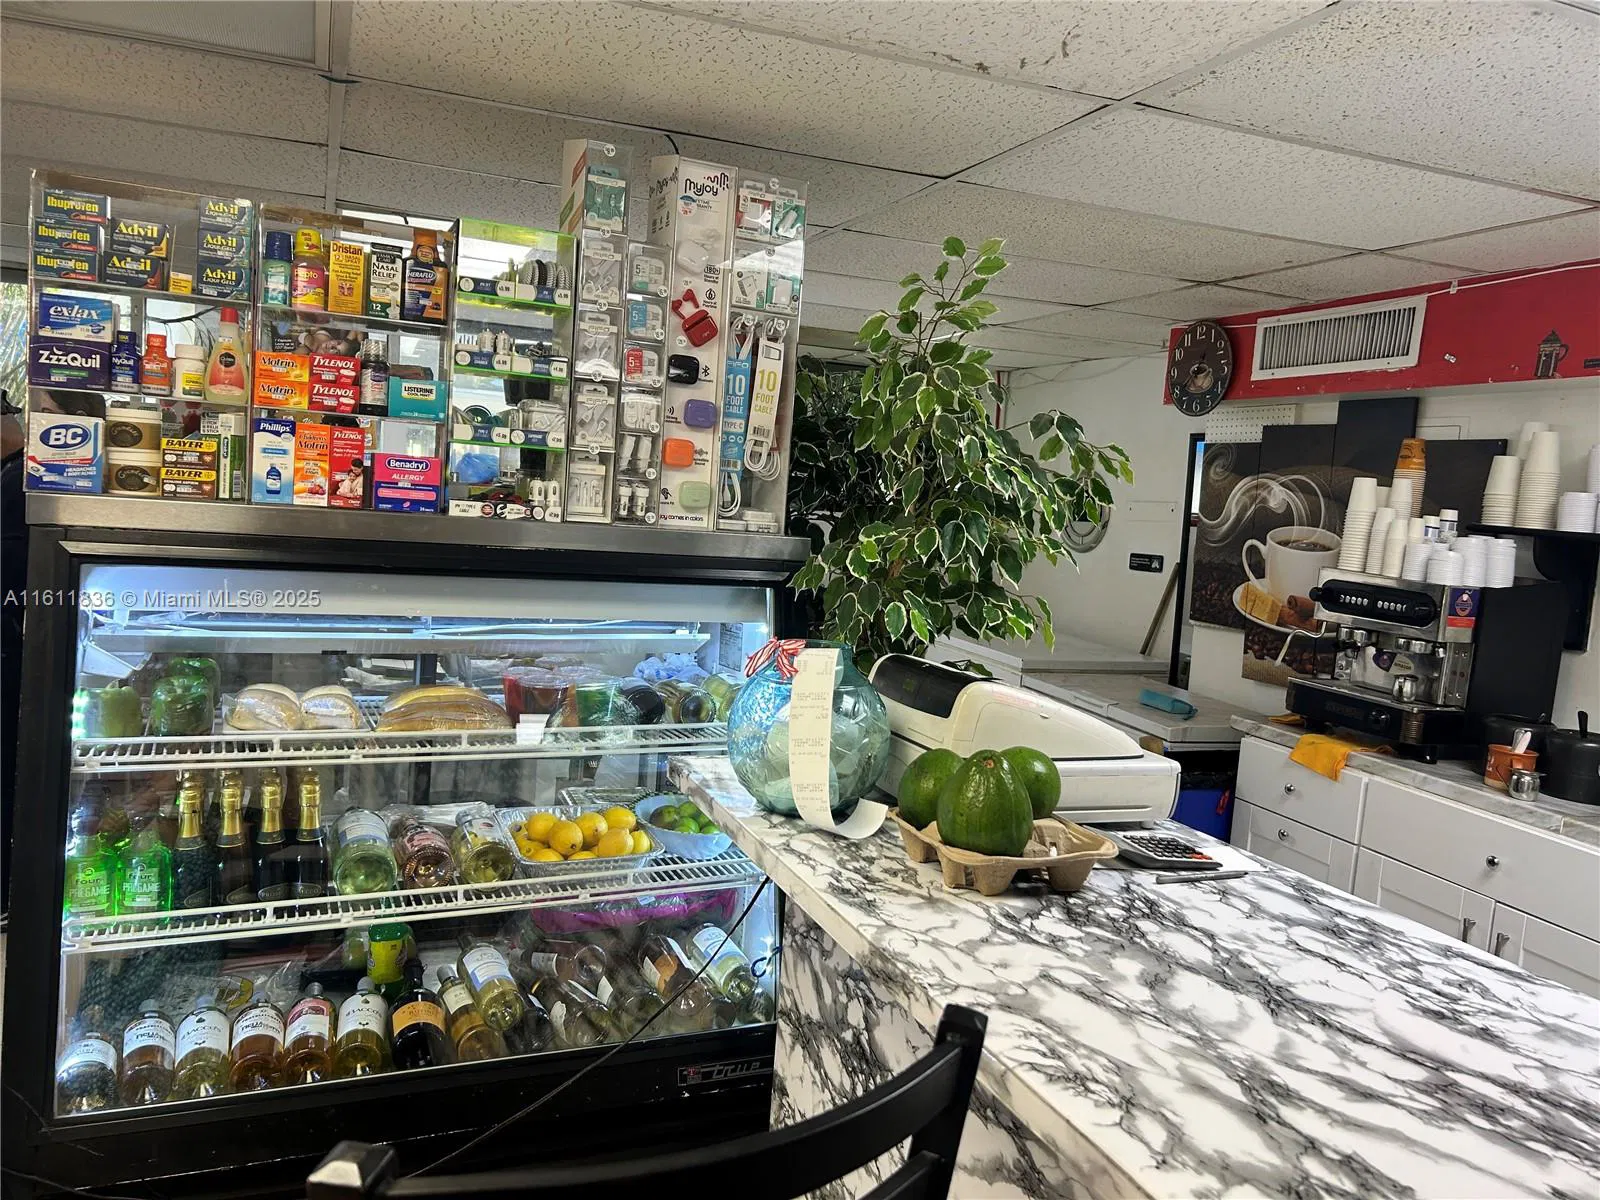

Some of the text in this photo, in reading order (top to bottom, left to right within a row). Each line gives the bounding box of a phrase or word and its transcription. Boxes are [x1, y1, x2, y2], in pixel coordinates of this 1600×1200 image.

[47, 195, 99, 213] Ibuprofen
[205, 200, 239, 215] Advil
[114, 221, 158, 239] Advil
[204, 233, 237, 248] Advil
[332, 242, 363, 256] Dristan
[203, 267, 237, 281] Advil
[372, 262, 400, 273] NASAL
[372, 269, 397, 279] RELIEF
[294, 268, 318, 281] Pepto
[371, 303, 382, 311] 12
[1197, 325, 1206, 341] 12
[38, 346, 101, 369] ZzzQuil
[1175, 348, 1184, 361] 10
[112, 357, 134, 367] NyQuil
[262, 356, 295, 368] Motrin
[313, 356, 355, 369] TYLENOL
[1170, 366, 1178, 380] 9
[727, 373, 746, 396] 10
[758, 368, 778, 392] 10
[261, 383, 295, 395] Motrin
[312, 384, 354, 397] TYLENOL
[404, 386, 434, 395] LISTERINE
[1173, 385, 1180, 398] 8
[726, 395, 744, 406] FOOT
[755, 392, 775, 405] FOOT
[725, 405, 744, 414] CABLE
[754, 404, 774, 415] CABLE
[1192, 400, 1200, 412] 6
[48, 427, 83, 446] BC
[333, 431, 362, 440] TYLENOL
[165, 439, 204, 449] BAYER
[298, 440, 329, 450] Motrin
[389, 459, 427, 472] Benadryl
[164, 469, 203, 478] BAYER
